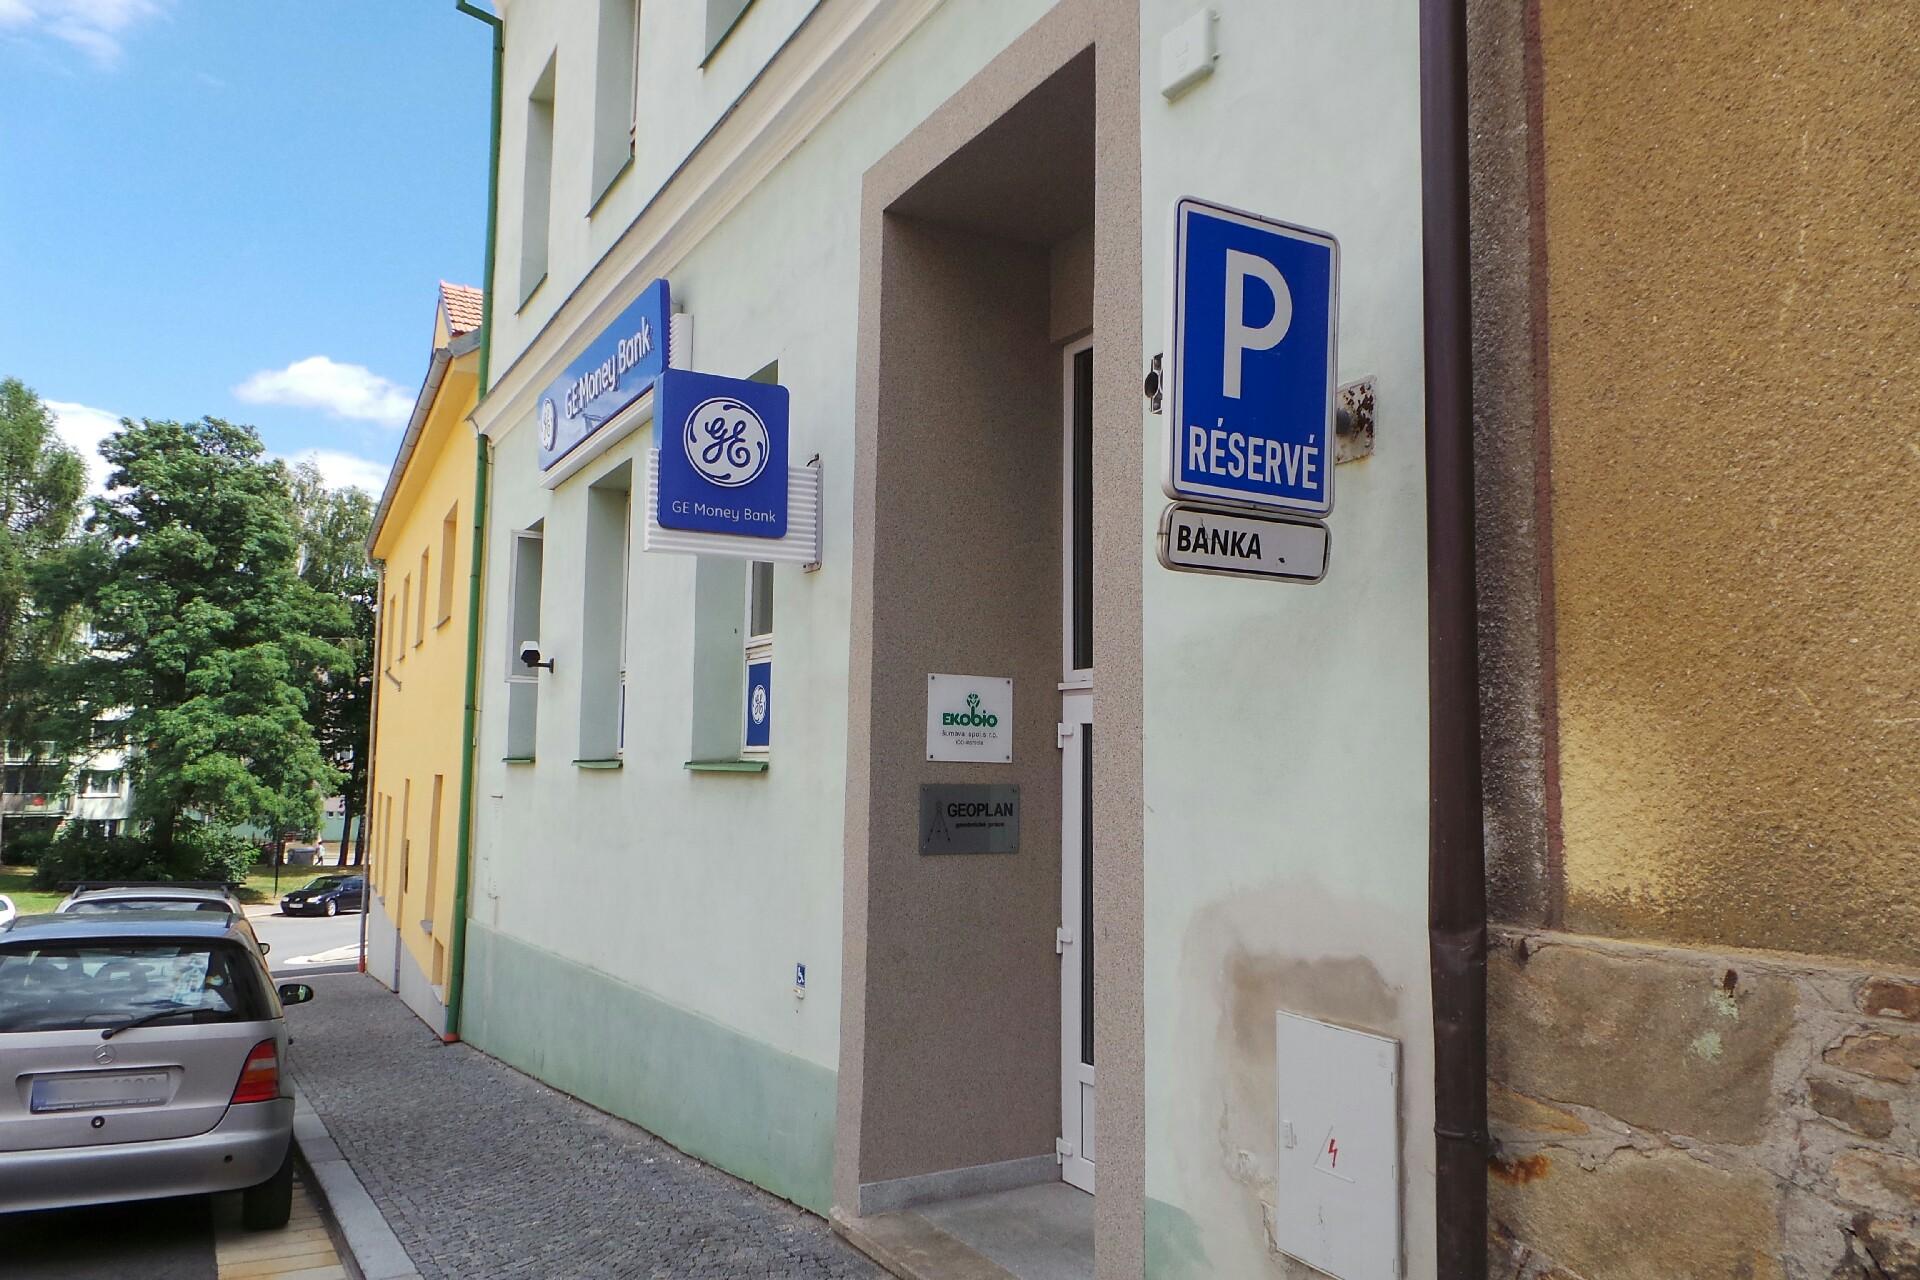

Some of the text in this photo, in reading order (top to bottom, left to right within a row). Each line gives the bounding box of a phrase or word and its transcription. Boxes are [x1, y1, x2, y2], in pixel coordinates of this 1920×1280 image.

[1223, 248, 1293, 400] P
[565, 316, 651, 419] GE Money Bank
[1188, 417, 1320, 490] RÉSERVÉ
[672, 500, 776, 523] GE Money Bank
[1176, 525, 1262, 560] BANKA
[947, 802, 1014, 818] GEOPLAN
